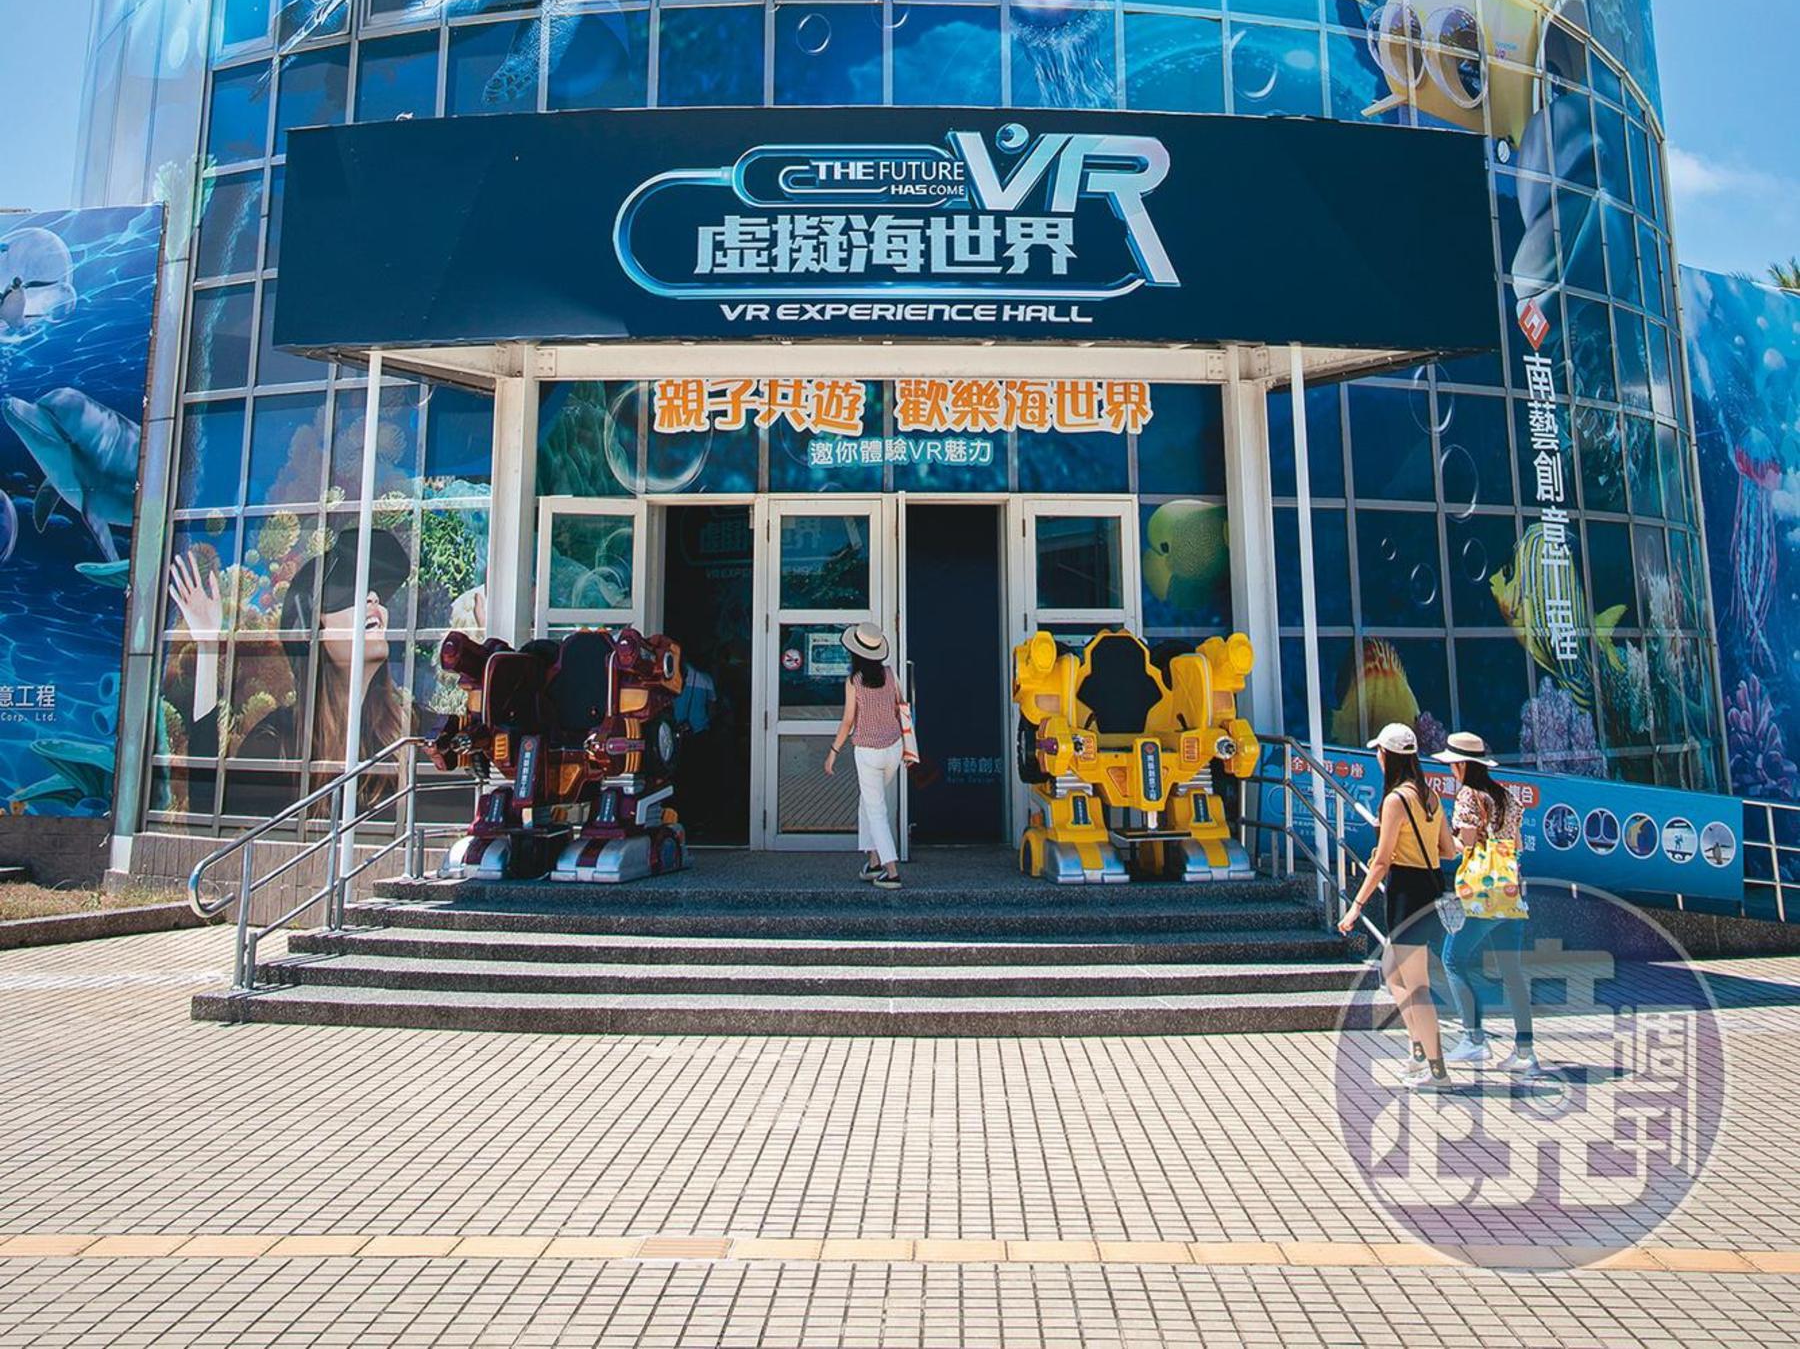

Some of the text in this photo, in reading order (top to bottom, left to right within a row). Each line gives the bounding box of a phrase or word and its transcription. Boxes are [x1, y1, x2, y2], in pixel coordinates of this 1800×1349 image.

[810, 161, 965, 181] THE FUTURE
[890, 184, 965, 196] HAS COME
[947, 131, 1181, 287] VR
[694, 215, 1078, 275] 虛擬海世界
[720, 304, 770, 321] VR
[1002, 305, 1093, 323] HALL
[656, 379, 1152, 433] 親子共遊 歡樂海世界
[810, 438, 991, 466] 邀你體驗VR魅力
[1523, 352, 1577, 660] 南藝創意工程
[0, 685, 56, 708] 意工程
[0, 712, 57, 723] Corp. Ltd.
